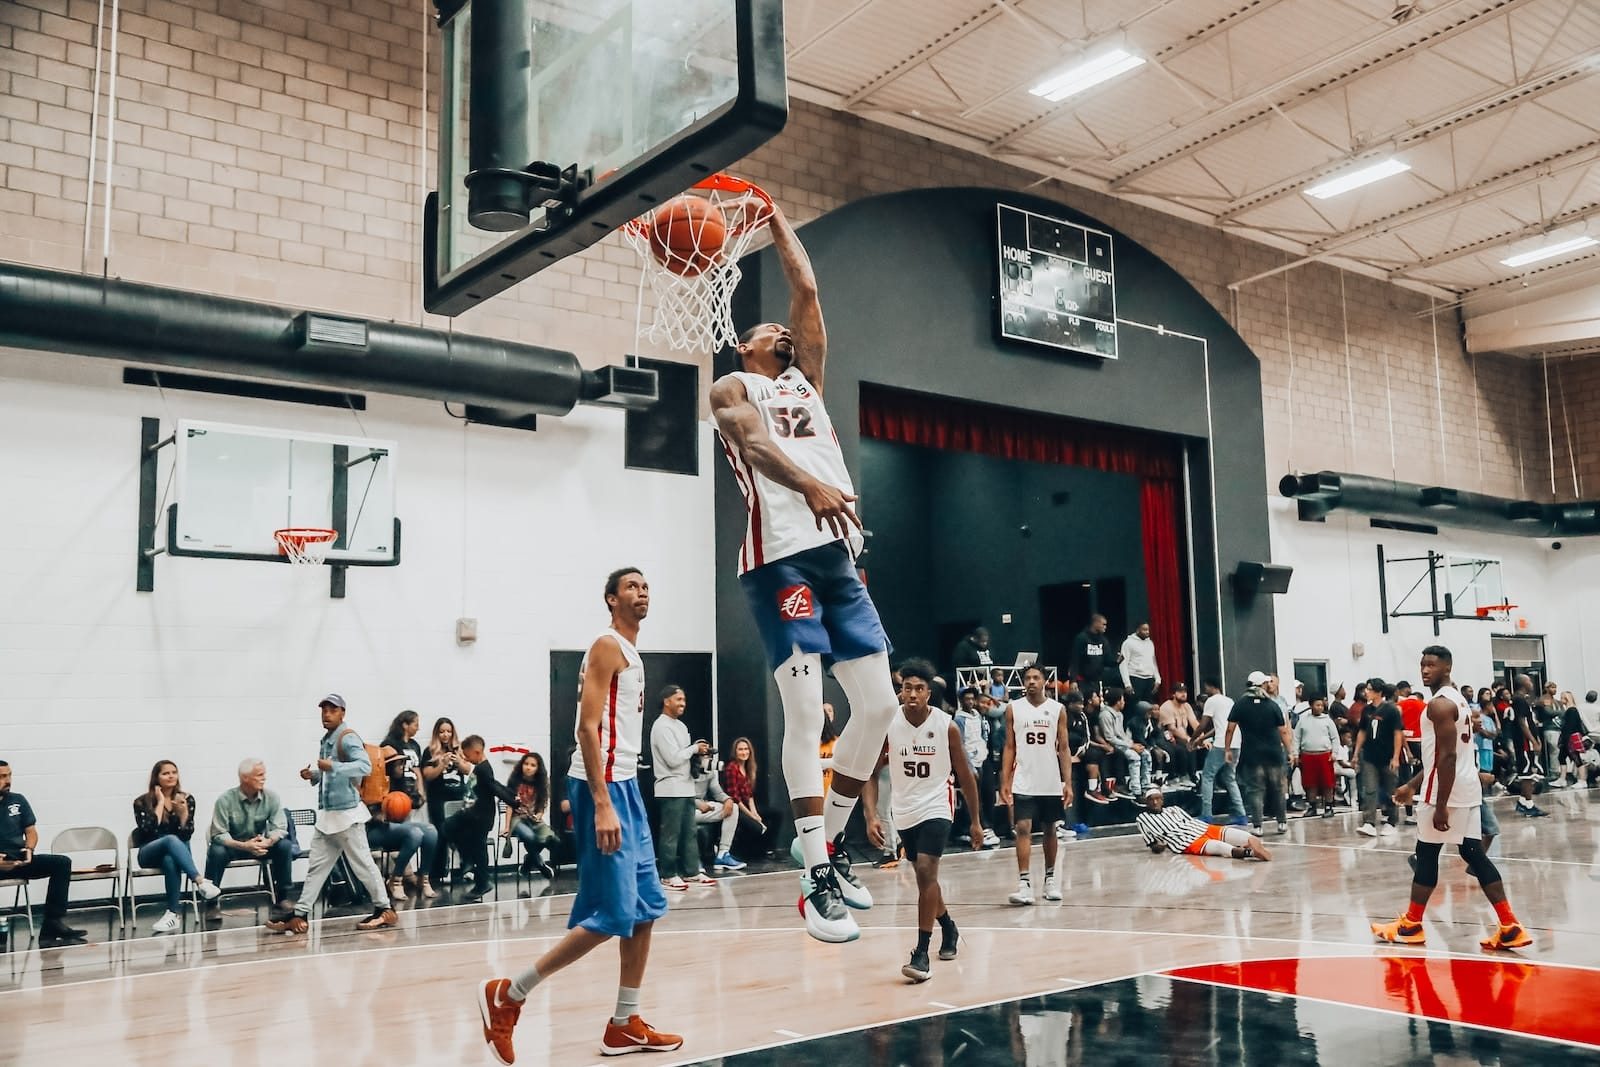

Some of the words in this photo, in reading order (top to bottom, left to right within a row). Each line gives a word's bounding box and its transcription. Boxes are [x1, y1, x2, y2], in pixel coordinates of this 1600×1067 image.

[1003, 245, 1031, 264] HOME
[1083, 266, 1112, 285] GUEST
[768, 406, 816, 438] 52
[1026, 732, 1046, 745] 69
[912, 745, 936, 753] WATTS
[903, 761, 930, 779] 50
